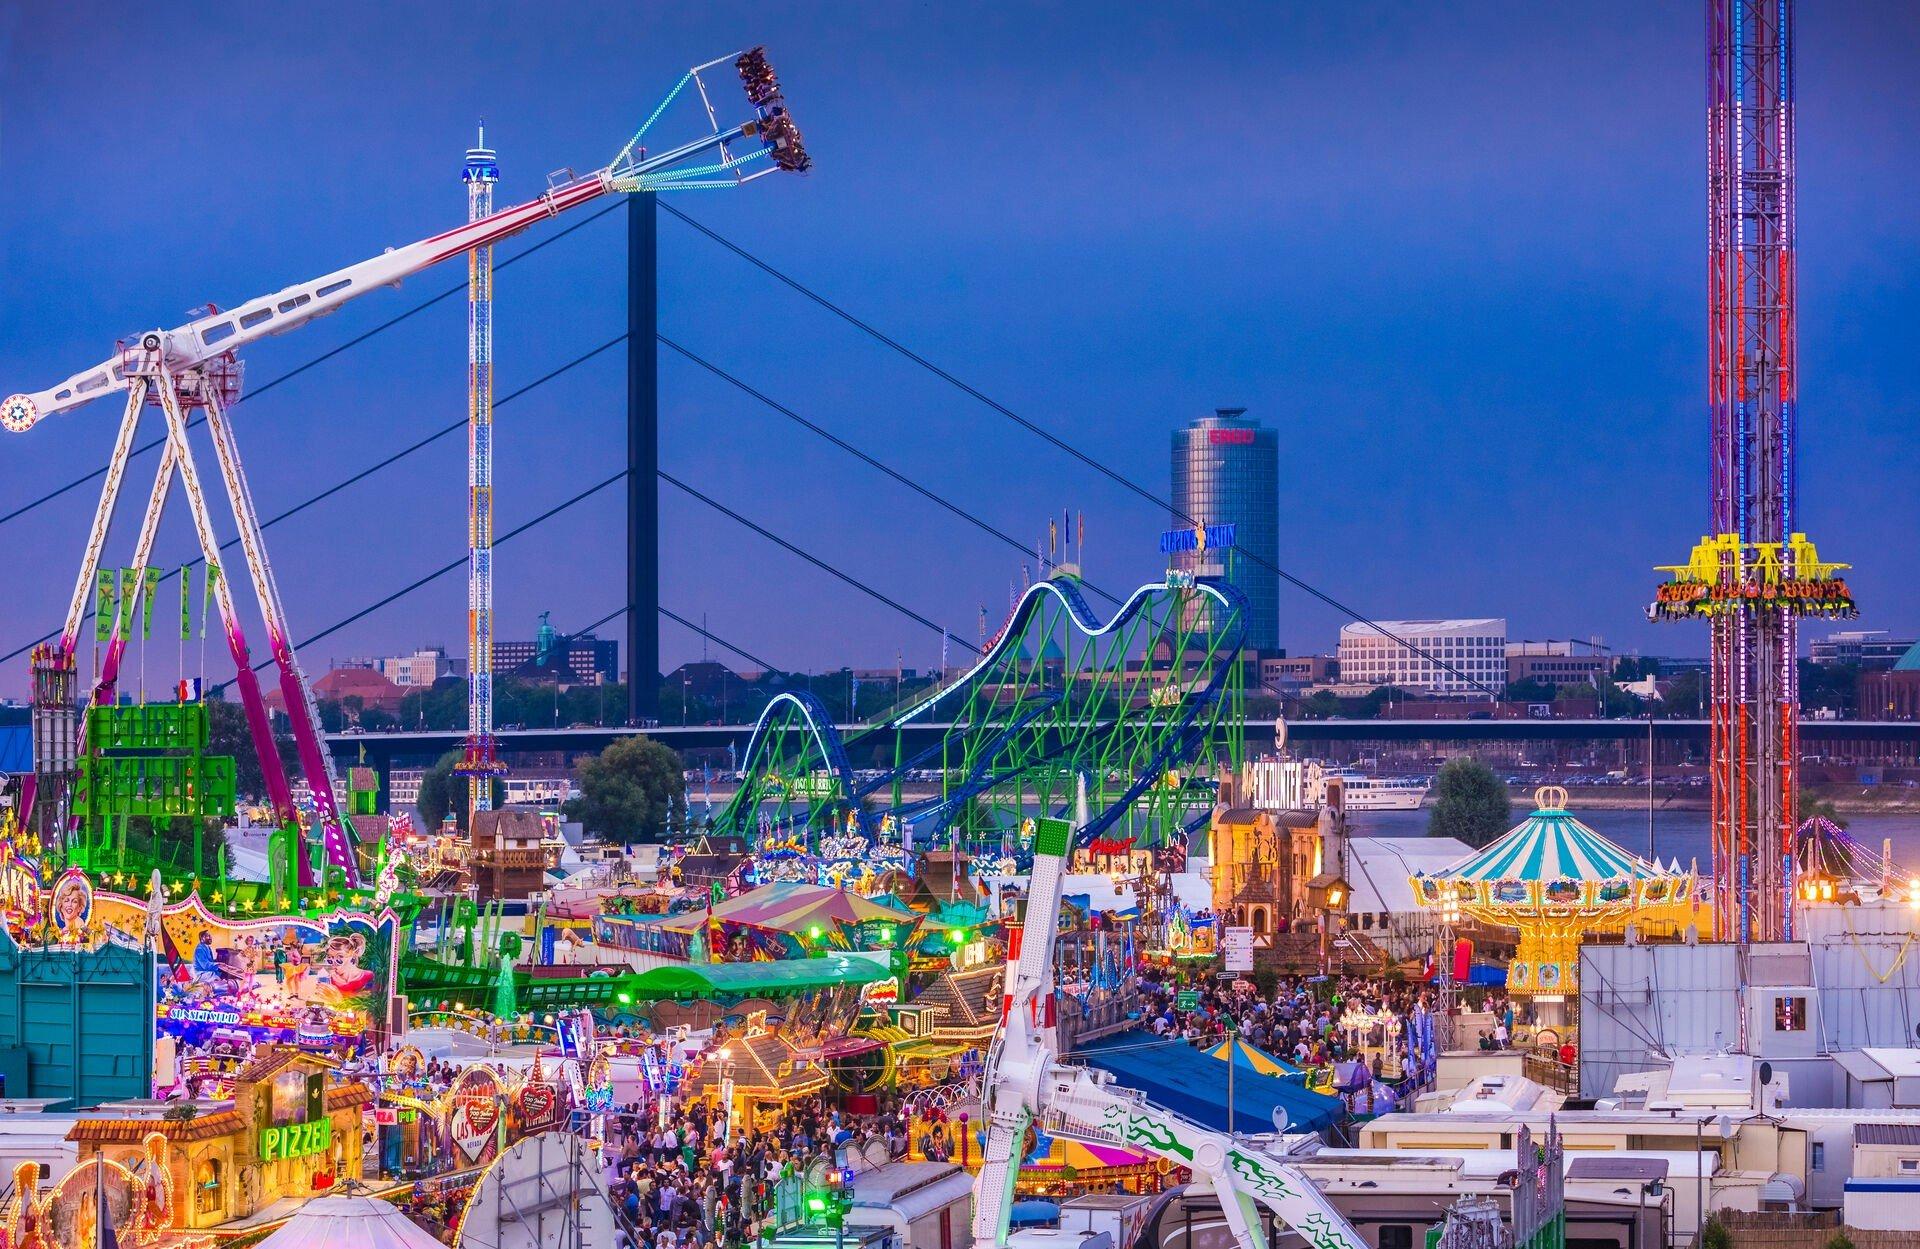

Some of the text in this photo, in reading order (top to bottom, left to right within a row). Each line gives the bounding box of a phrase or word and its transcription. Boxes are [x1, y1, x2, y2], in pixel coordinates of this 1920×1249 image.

[1209, 429, 1255, 444] ERGO
[1206, 524, 1236, 548] BAHN
[1253, 762, 1303, 809] ENCOUNTER
[456, 1122, 469, 1141] LAS
[466, 1139, 482, 1149] NEVADA
